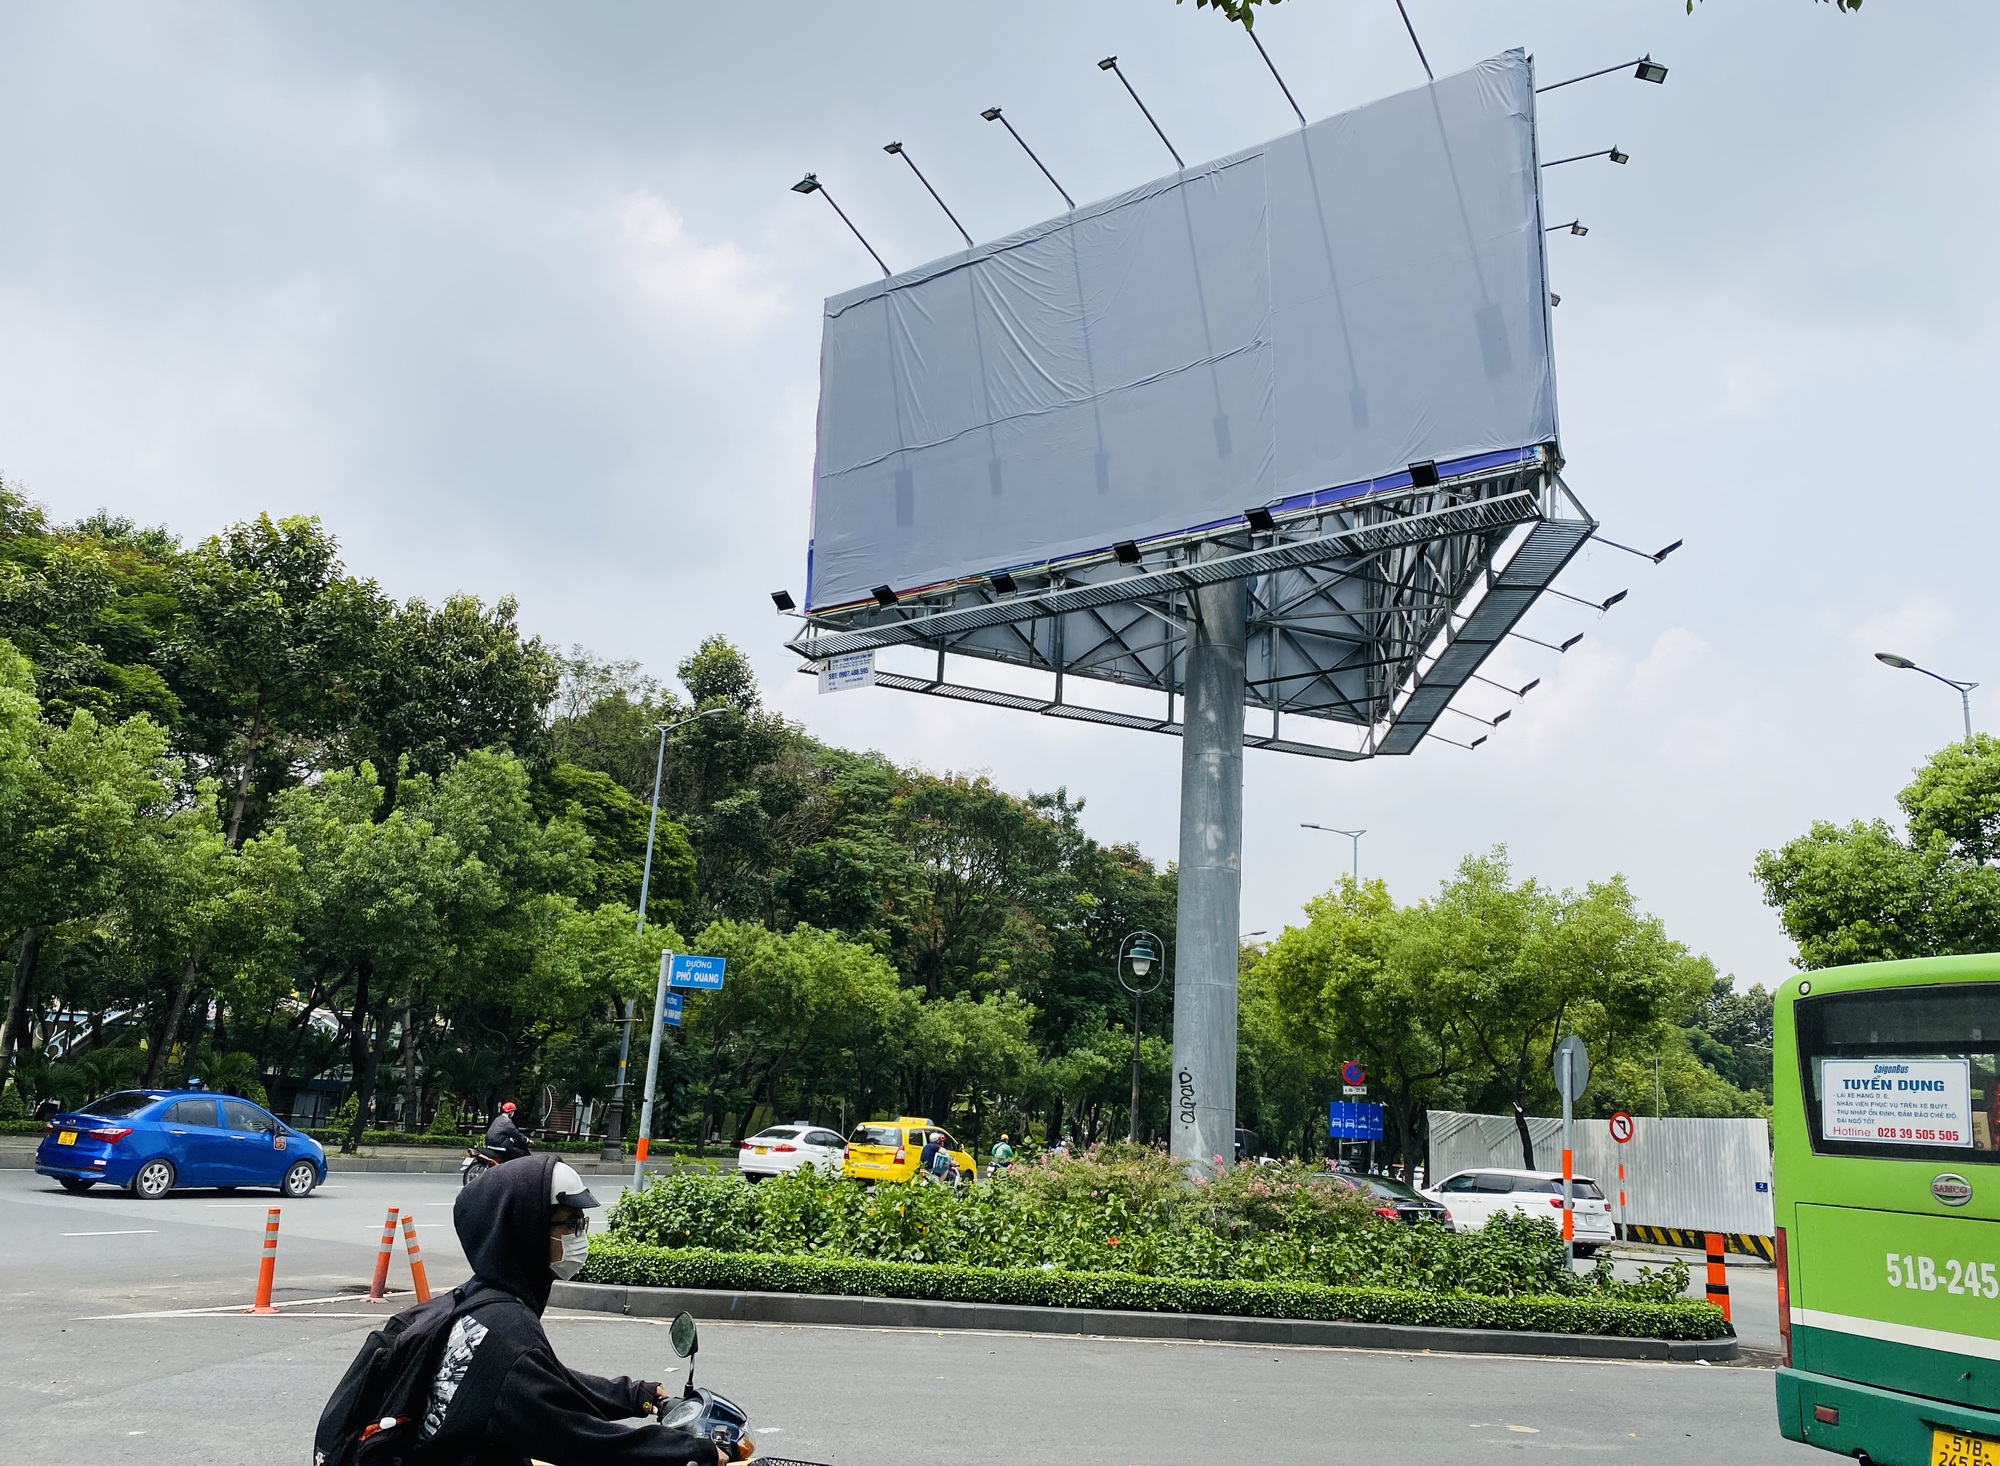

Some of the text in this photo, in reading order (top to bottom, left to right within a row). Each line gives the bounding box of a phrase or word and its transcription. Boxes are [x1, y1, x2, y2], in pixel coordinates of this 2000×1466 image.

[685, 960, 712, 969] ĐƯỜNG
[676, 967, 719, 984] PHỔ QUANG
[1873, 1064, 1909, 1074] SaigonBus
[1842, 1075, 1944, 1094] TUYỂN DỤNG
[1833, 1126, 1959, 1141] Hotline: 028 39 505 505
[1932, 1184, 1968, 1194] SAMCO
[1886, 1253, 1999, 1299] 51B-245
